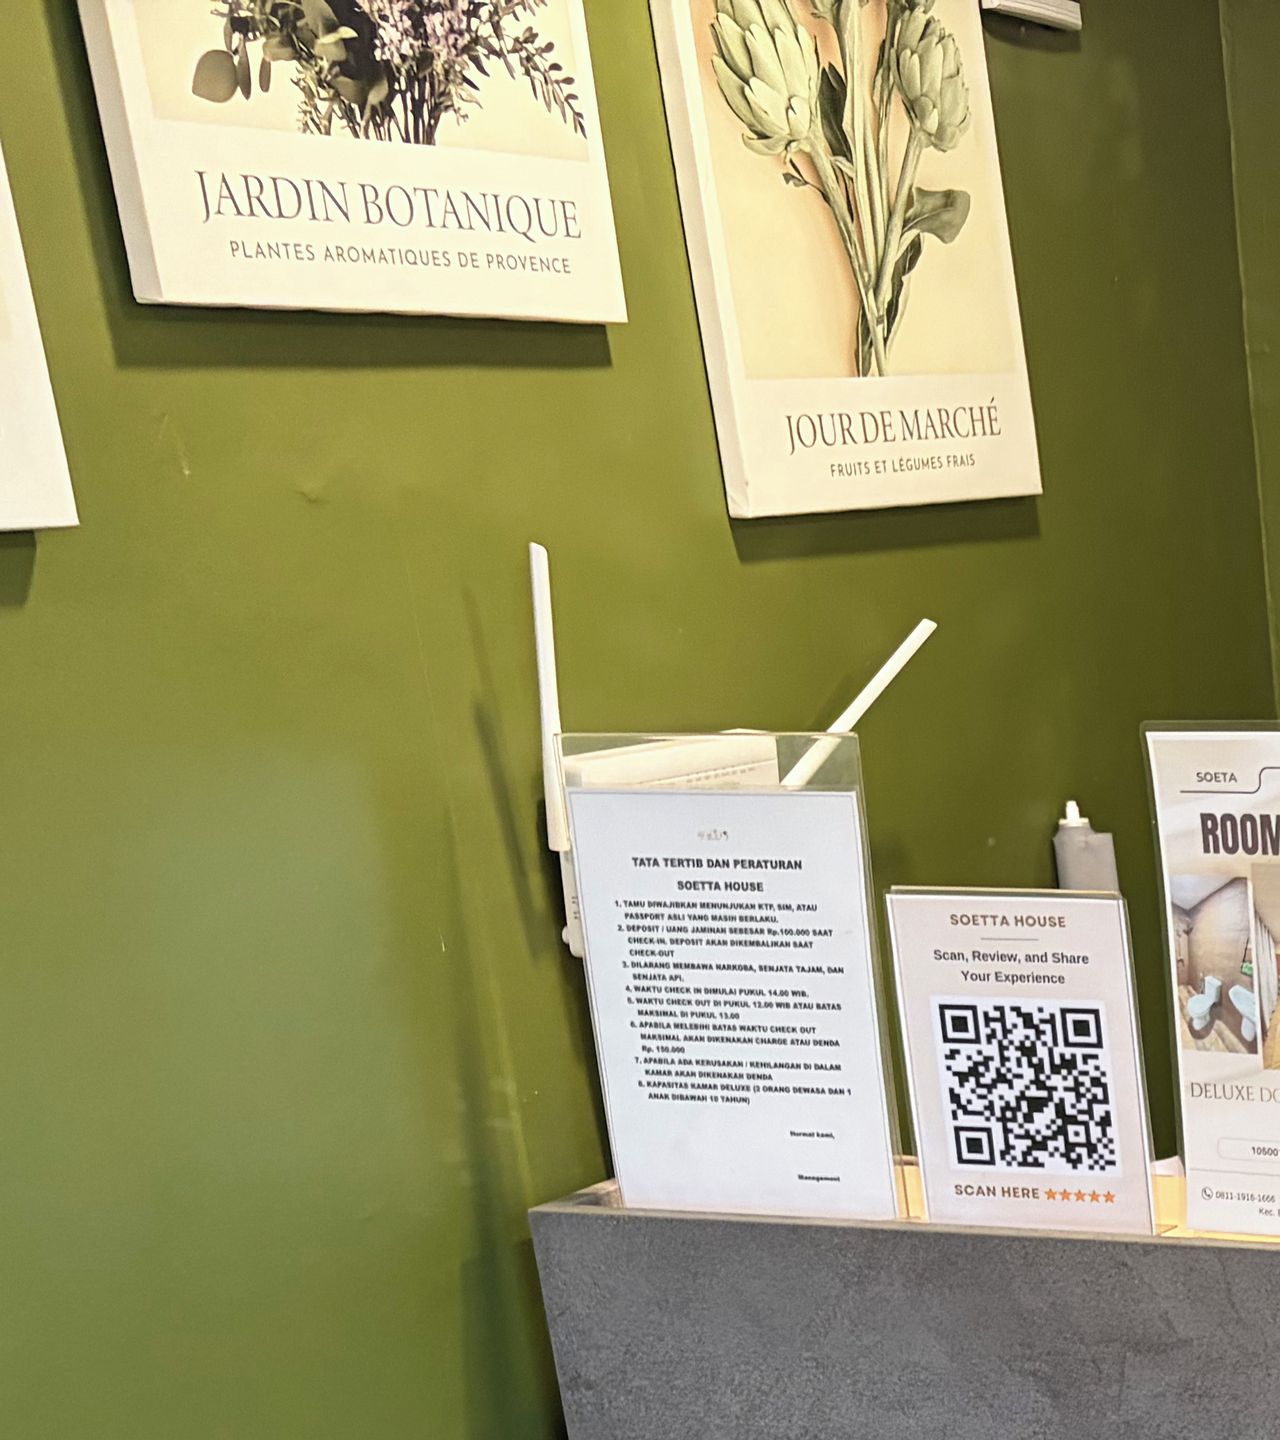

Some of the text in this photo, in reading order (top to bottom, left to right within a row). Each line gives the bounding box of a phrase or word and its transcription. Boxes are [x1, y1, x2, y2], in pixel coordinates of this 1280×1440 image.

[194, 170, 581, 243] JARDIN BOTANIQUE
[230, 240, 570, 274] PLANTES AROMATIQUES DE PROVENCE
[786, 397, 1001, 455] JOUR DE MARCHÉ
[830, 453, 975, 477] FRUITS ET LÉGUMES FRAIS
[1196, 772, 1237, 783] SOETA
[633, 857, 802, 870] TATA TERTIB DAN PERATURAN
[678, 881, 763, 892] SOETTA HOUSE
[624, 900, 645, 909] TAMU
[700, 902, 756, 911] MENUNJUKAN
[797, 903, 817, 912] ATAU
[625, 912, 664, 921] PASSPORT
[668, 913, 685, 921] ASLI
[689, 913, 709, 922] YANG
[711, 914, 736, 922] MASIH
[950, 914, 1066, 928] SOETTA HOUSE
[626, 925, 659, 933] DEPOSIT
[666, 925, 688, 934] UANG
[692, 926, 726, 935] JAMINAN
[730, 927, 764, 935] SEBESAR
[813, 928, 833, 937] SAAT
[670, 938, 703, 947] DEPOSIT
[706, 939, 727, 948] AKAN
[730, 940, 790, 949] DIKEMBALIKAN
[793, 941, 813, 949] SAAT
[934, 949, 1089, 964] Scan, Review, and Share
[631, 961, 670, 970] DILARANG
[673, 962, 713, 971] MEMBAWA
[759, 965, 793, 974] SENJATA
[828, 967, 844, 975] DAN
[633, 973, 666, 982] SENJATA
[962, 970, 1065, 985] Your Experience
[634, 985, 661, 994] WAKTU
[665, 986, 690, 994] CHECK
[694, 987, 701, 995] IN
[704, 987, 736, 996] DIMULAI
[739, 988, 765, 997] PUKUL
[636, 997, 664, 1006] WAKTU
[667, 998, 692, 1007] CHECK
[696, 999, 710, 1007] OUT
[713, 999, 721, 1007] DI
[724, 1000, 750, 1008] PUKUL
[776, 1001, 789, 1010] WIB
[793, 1002, 813, 1011] ATAU
[816, 1003, 841, 1012] BATAS
[638, 1009, 677, 1018] MAKSIMAL
[681, 1010, 689, 1019] DI
[691, 1011, 717, 1020] PUKUL
[640, 1021, 816, 1034] APABILA MELEBIHI BATAS WAKTU CHECK OUT
[641, 1033, 839, 1047] MAKSIMAL AKAN DIKENAKAN CHARGE ATAU DENDA
[644, 1057, 674, 1066] APABILA
[678, 1058, 693, 1066] ADA
[696, 1058, 743, 1068] KERUSAKAN
[750, 1060, 801, 1070] KEHILANGAN
[804, 1062, 812, 1070] DI
[814, 1063, 842, 1072] DALAM
[645, 1069, 772, 1082] KAMAR AKAN DIKENAKAN DENDA
[647, 1081, 688, 1090] KAPASITAS
[691, 1082, 717, 1091] KAMAR
[721, 1083, 751, 1092] DELUXE
[763, 1085, 790, 1094] ORANG
[793, 1086, 825, 1095] DEWASA
[829, 1087, 845, 1096] DAN
[1190, 1082, 1254, 1102] DELUXE
[649, 1093, 669, 1102] ANAK
[672, 1094, 706, 1104] DIBAWAH
[955, 1184, 1040, 1199] SCAN HERE
